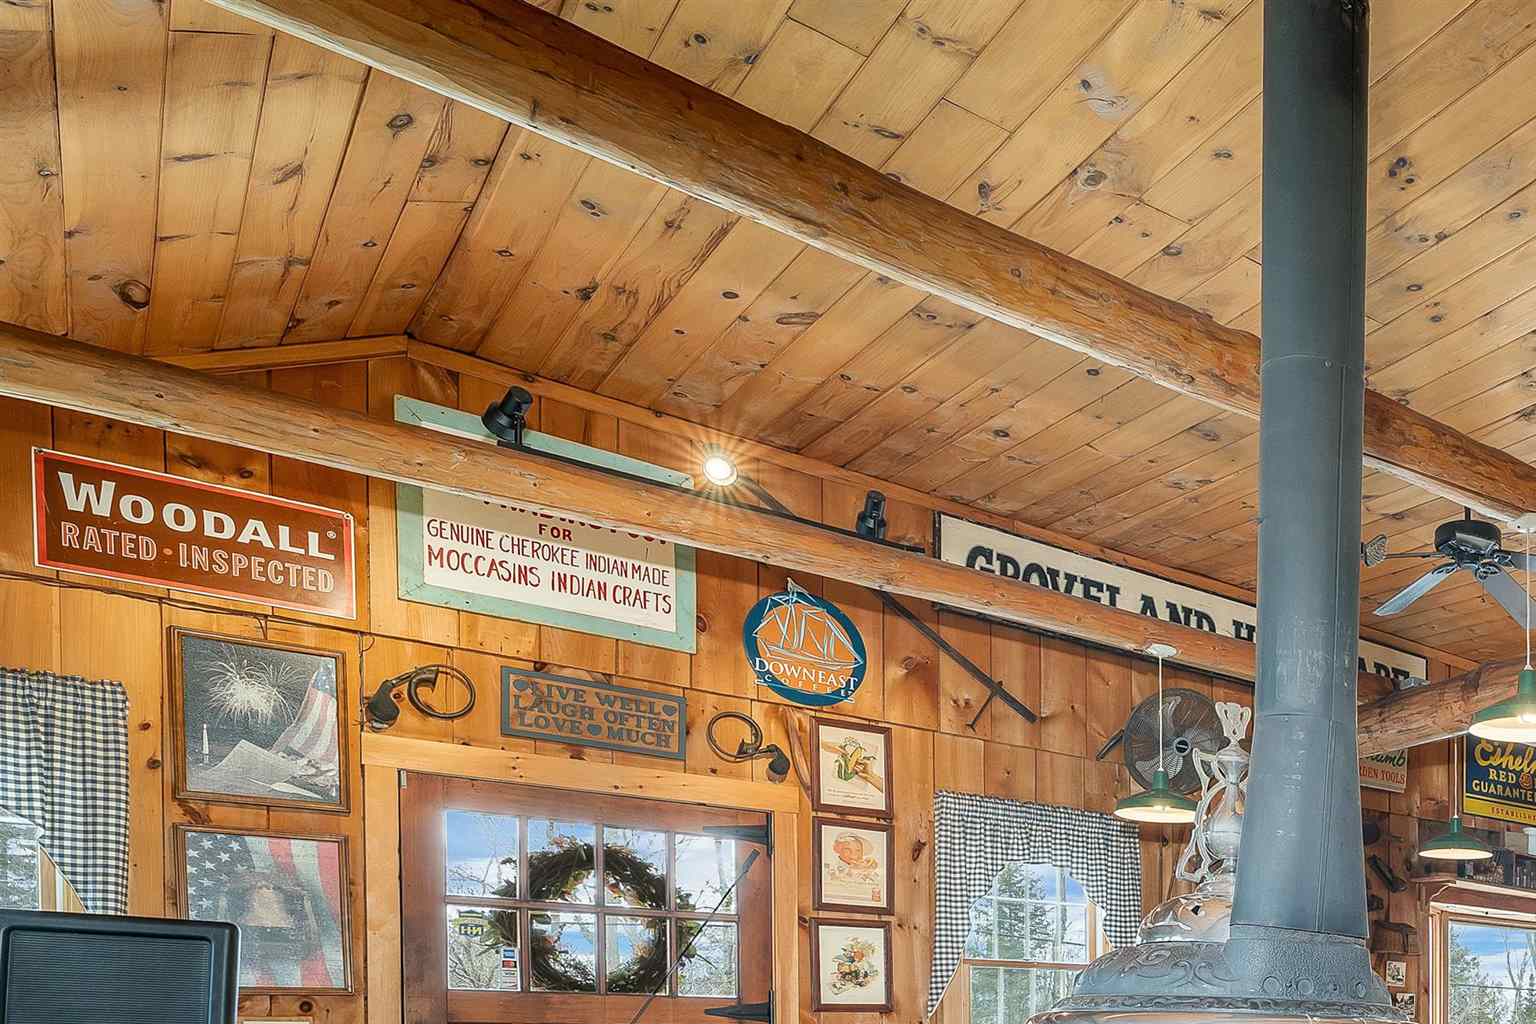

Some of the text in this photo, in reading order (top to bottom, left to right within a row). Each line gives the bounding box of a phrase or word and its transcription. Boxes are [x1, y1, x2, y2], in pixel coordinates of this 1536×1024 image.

[58, 471, 336, 560] WOODALL
[538, 522, 573, 542] FOR
[60, 520, 335, 594] RATED INSPECTED
[427, 518, 495, 550] GENUINE
[499, 534, 580, 568] CHEROKEE
[585, 552, 629, 578] INDIAN
[631, 563, 671, 587] MADE
[426, 543, 673, 615] MOCCASINS INDIAN CRAFTS
[754, 657, 858, 691] DOWNEAST
[513, 693, 678, 734] LAUGH OFTEN
[595, 691, 662, 716] WELL
[517, 709, 673, 749] LOVE MUCH
[1381, 769, 1406, 785] TOOLS
[1488, 768, 1517, 785] RED
